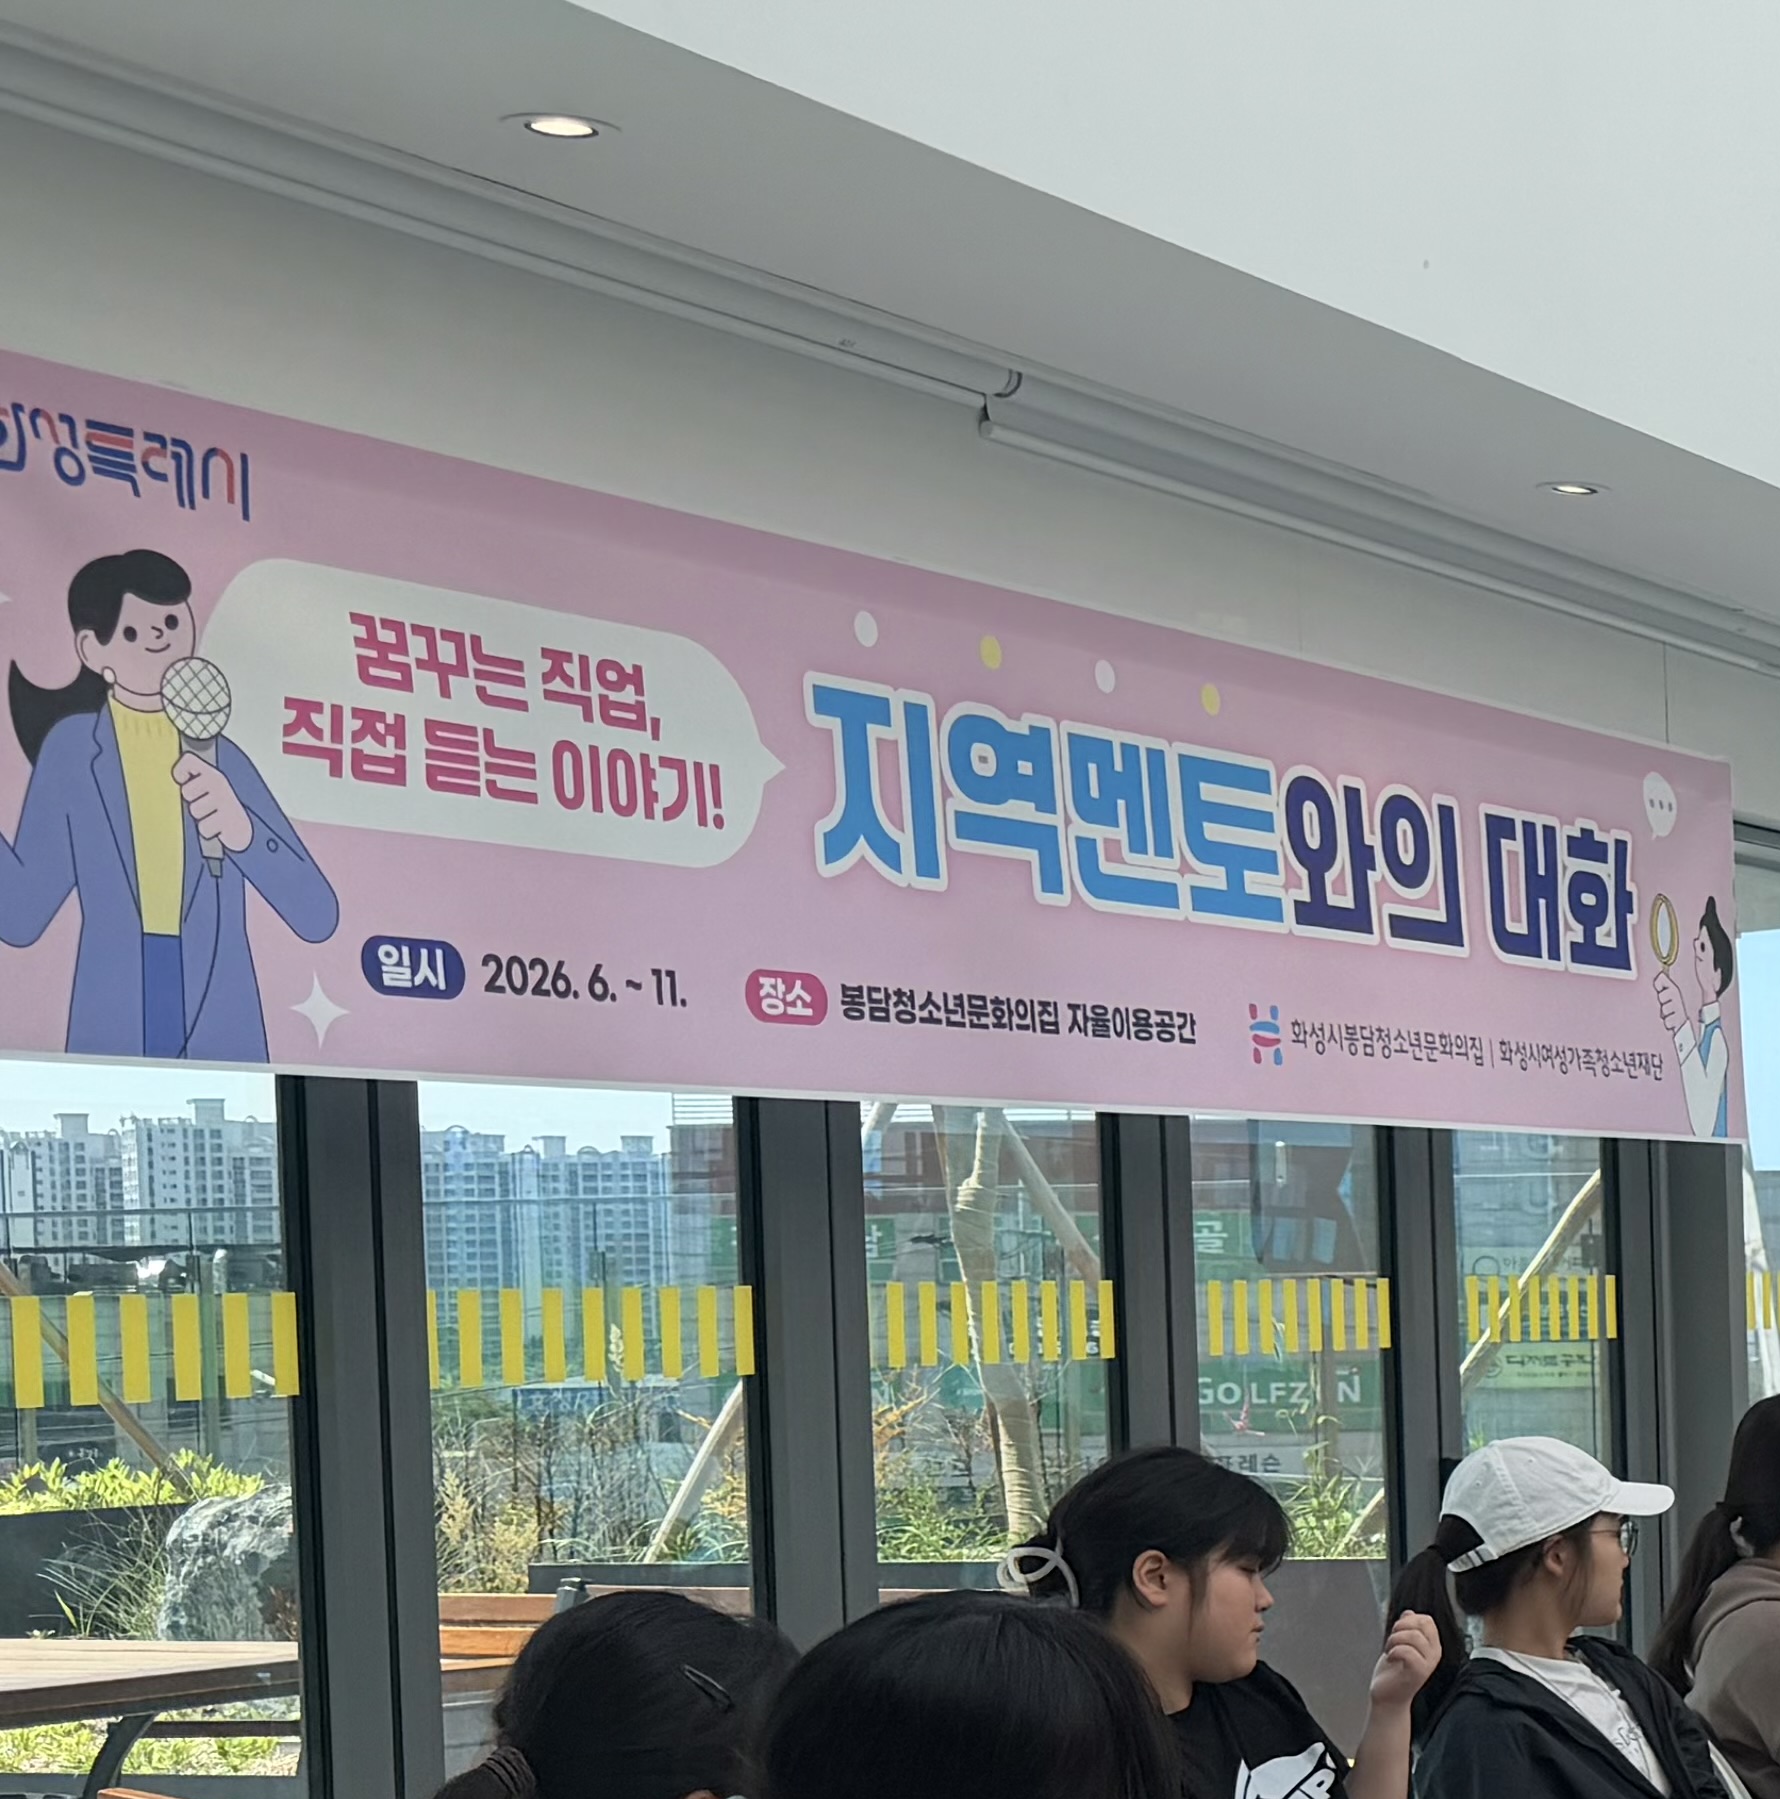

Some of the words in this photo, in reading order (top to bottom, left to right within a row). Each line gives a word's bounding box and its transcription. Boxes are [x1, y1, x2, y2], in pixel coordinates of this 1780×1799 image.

[349, 611, 529, 713] 꿈꾸는
[541, 646, 661, 742] 직업,
[282, 696, 407, 788] 직접
[424, 717, 539, 805] 듣는
[552, 739, 725, 830] 이야기!
[809, 679, 1467, 951] 지역멘토와의
[1482, 809, 1636, 974] 대화
[377, 943, 447, 991] 일시
[650, 968, 687, 1007] 11.
[758, 975, 815, 1017] 장소
[840, 983, 1060, 1035] 봉담청소년문화의집
[1067, 1001, 1197, 1046] 자율이용공간
[1290, 1018, 1485, 1068] 화성시봉담청소년문화의집
[1499, 1039, 1664, 1082] 화성시여성가족청소년재단
[1197, 1376, 1361, 1405] GOLFZN
